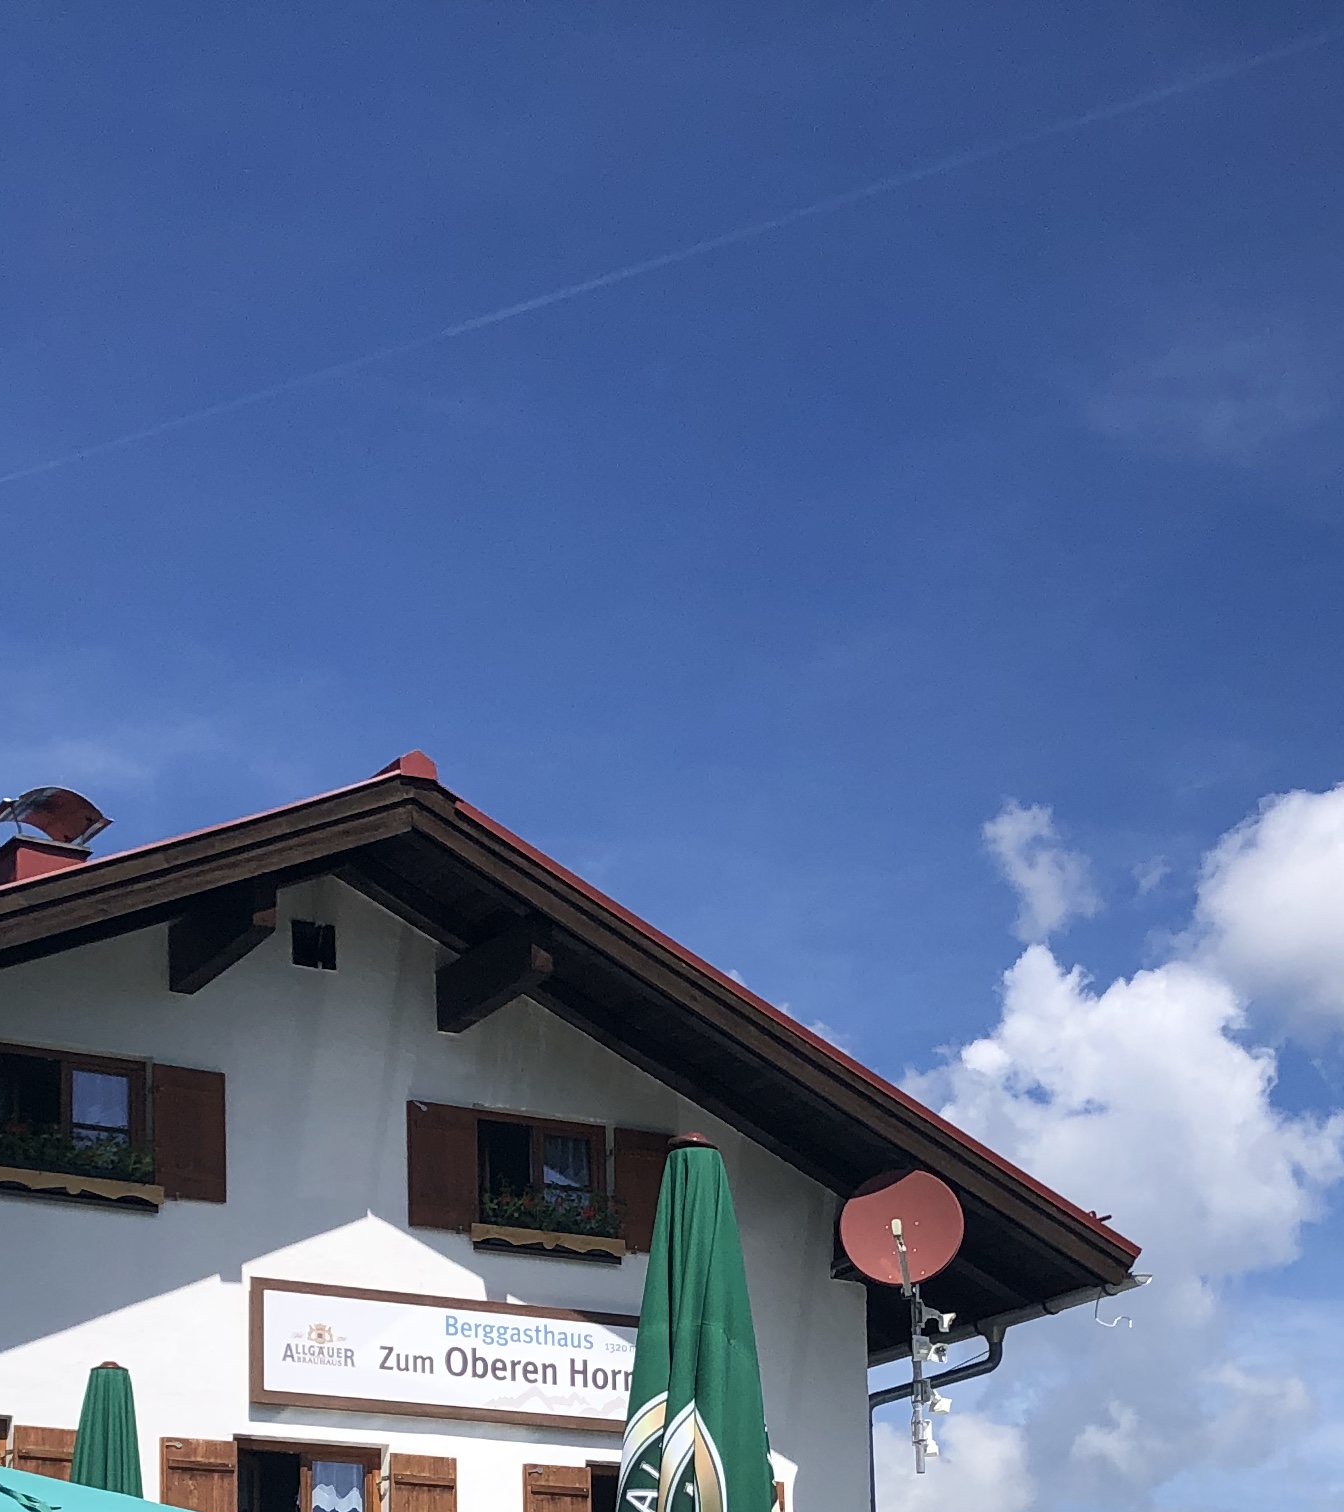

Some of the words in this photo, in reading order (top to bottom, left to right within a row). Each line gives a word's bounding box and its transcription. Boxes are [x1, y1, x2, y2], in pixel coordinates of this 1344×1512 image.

[445, 1315, 594, 1350] Berggasthaus
[605, 1342, 628, 1354] 1320
[282, 1342, 356, 1367] ALLGÄUER
[297, 1356, 343, 1367] BRAUHAUS
[379, 1345, 434, 1375] Zum
[444, 1346, 558, 1386] Oberen
